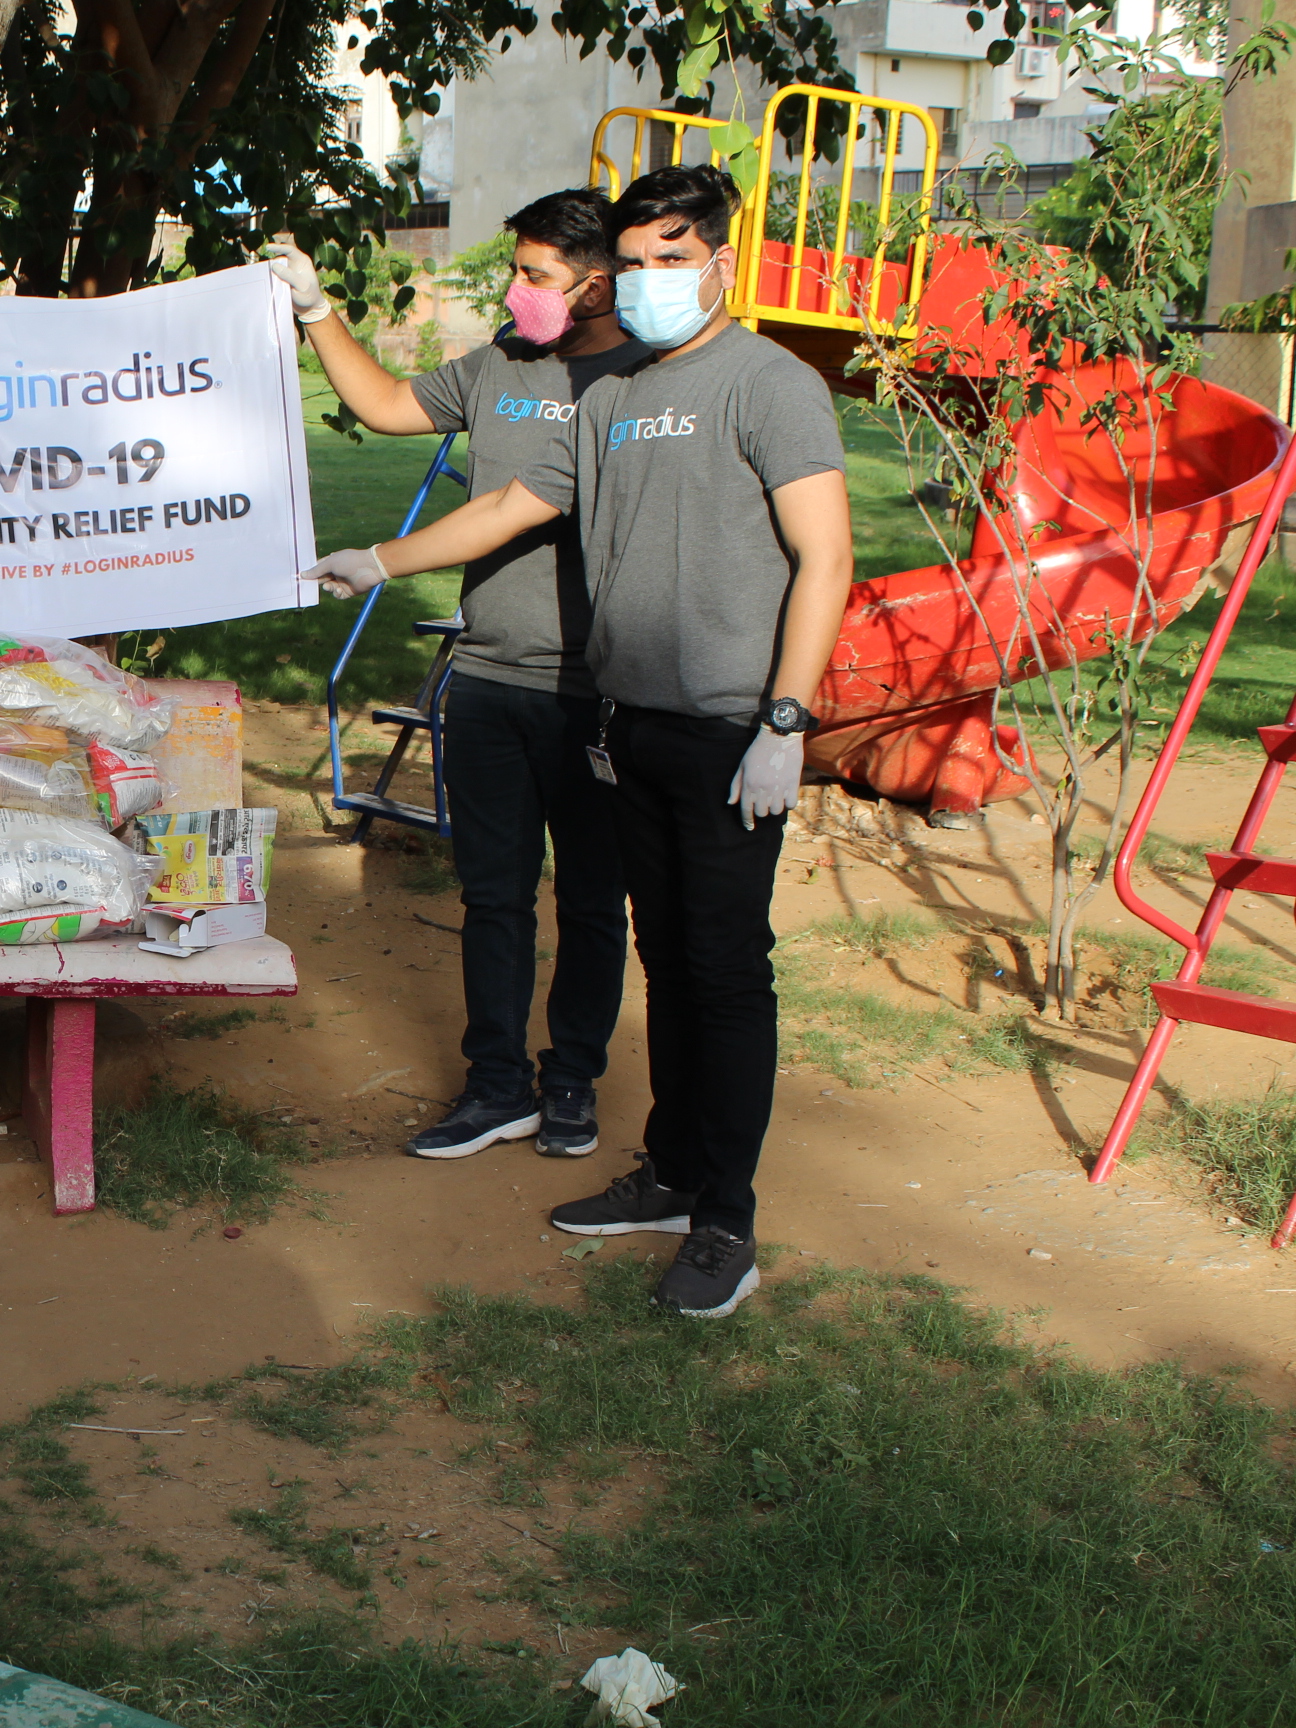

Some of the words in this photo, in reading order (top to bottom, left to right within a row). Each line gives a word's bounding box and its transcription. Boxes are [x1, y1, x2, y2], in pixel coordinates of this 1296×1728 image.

[495, 392, 580, 423] loginrad
[610, 408, 697, 451] ginradius
[52, 505, 154, 541] RELIEF
[163, 493, 251, 530] FUND
[32, 563, 55, 578] BY
[61, 548, 195, 576] #LOGINRADIUS
